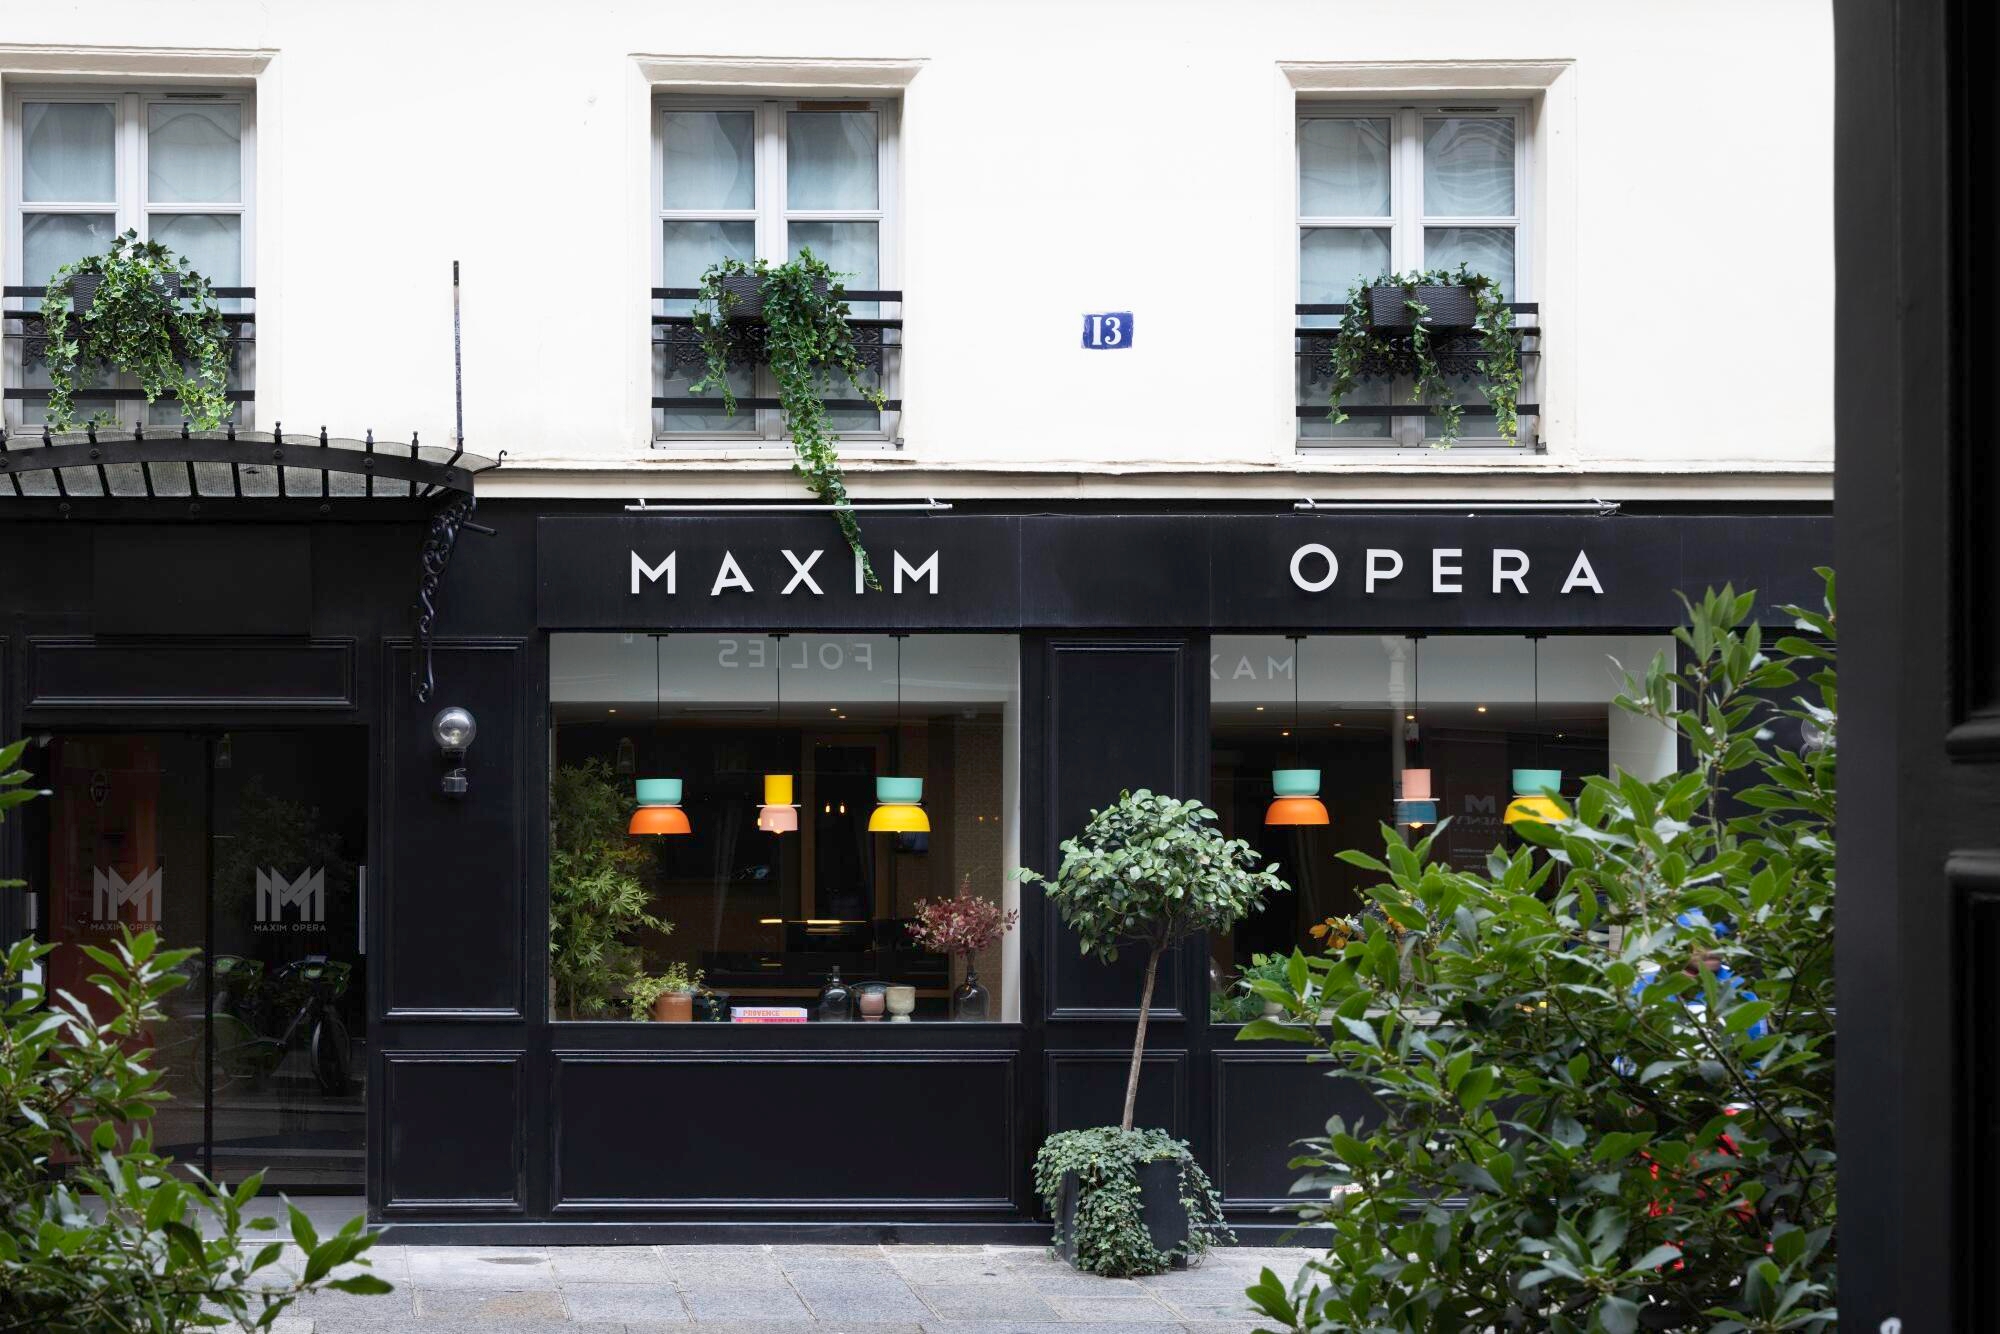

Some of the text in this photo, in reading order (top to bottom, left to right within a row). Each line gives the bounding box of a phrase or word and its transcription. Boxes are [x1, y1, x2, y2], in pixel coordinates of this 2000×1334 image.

[1092, 316, 1122, 346] 13
[630, 543, 1605, 596] MAXIM OPERA
[254, 924, 327, 932] MAXIM OPERA
